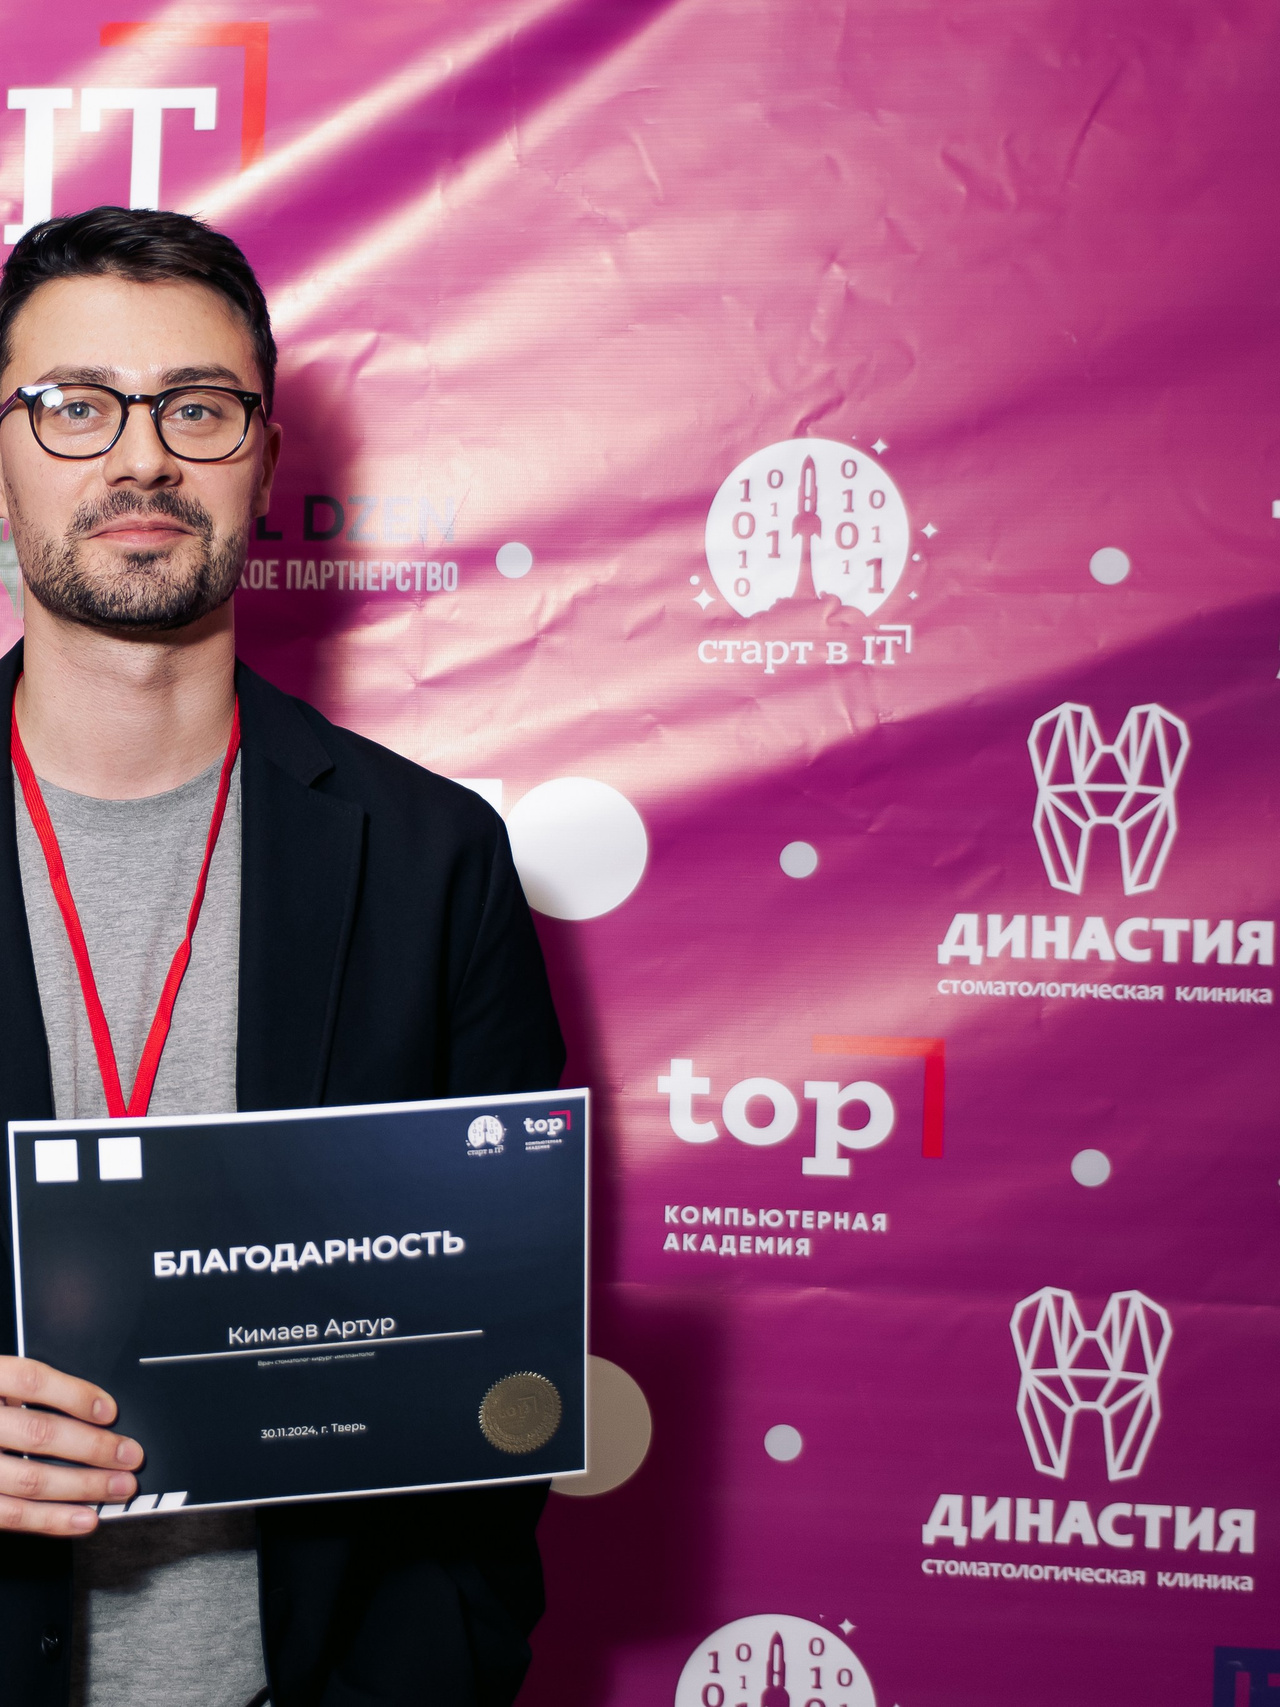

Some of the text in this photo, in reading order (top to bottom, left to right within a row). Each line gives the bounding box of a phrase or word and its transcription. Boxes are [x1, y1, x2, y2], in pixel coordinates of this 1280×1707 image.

[4, 87, 217, 246] IT
[303, 495, 455, 542] DZEN
[286, 560, 458, 592] ПАРТНЕРСТВО
[697, 635, 902, 674] старт в IT
[936, 912, 1275, 966] ДИНАСТИЯ
[936, 977, 1273, 1004] стоматологическая клиника
[523, 1117, 564, 1136] top
[657, 1057, 895, 1177] top
[663, 1204, 888, 1233] КОМПЬЮТЕРНАЯ
[153, 1230, 465, 1277] БЛАГОДАРНОСТЬ
[662, 1232, 811, 1257] АКАДЕМИЯ
[228, 1316, 396, 1346] Кимаев Артур
[260, 1422, 367, 1440] 30.11.2024, г. Тверь
[921, 1493, 1256, 1554] ДИНАСТИЯ
[921, 1558, 1254, 1592] стоматологическая клиника
